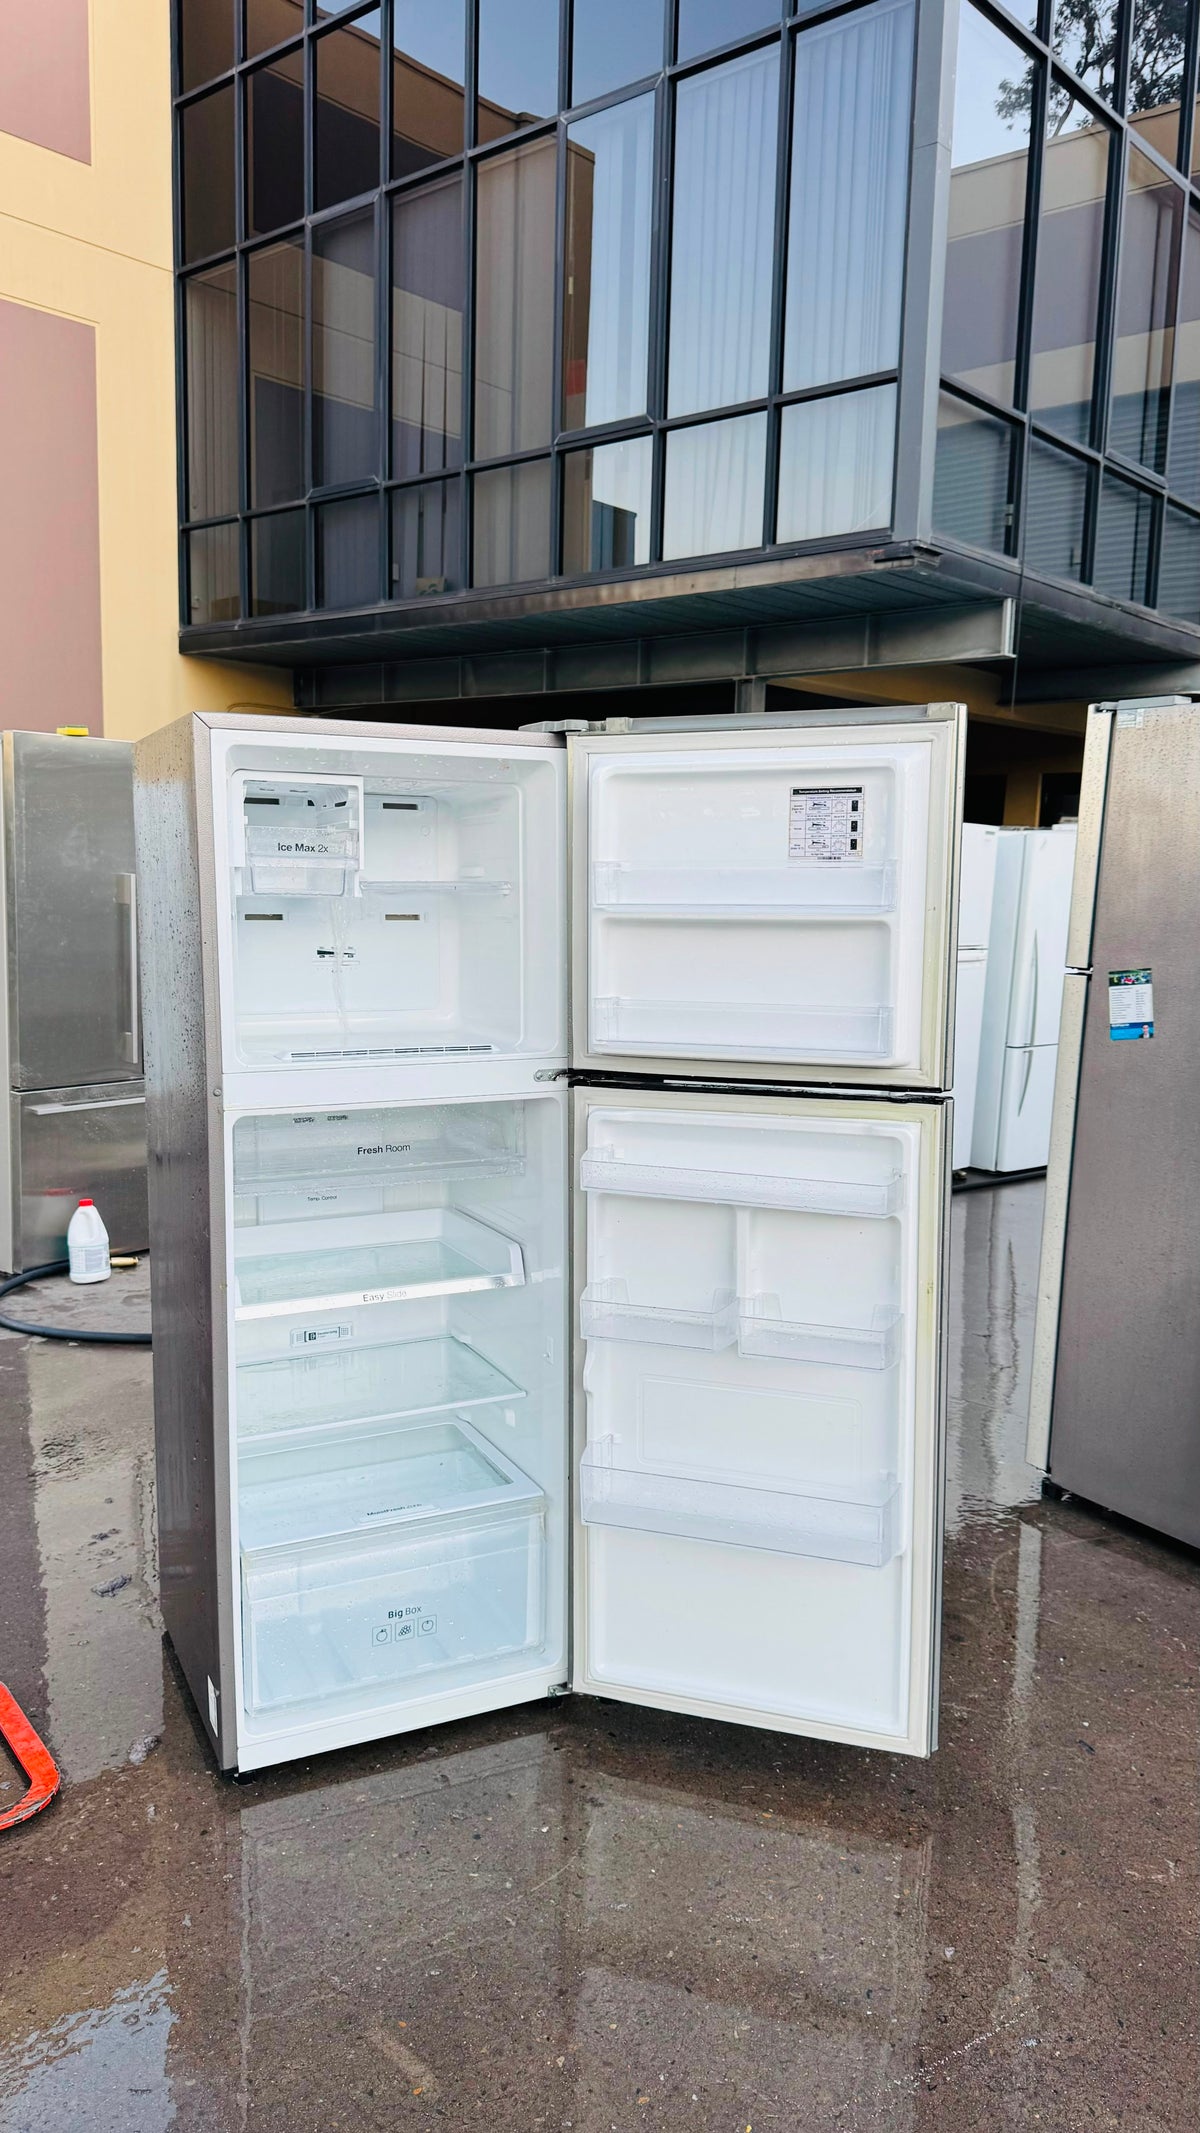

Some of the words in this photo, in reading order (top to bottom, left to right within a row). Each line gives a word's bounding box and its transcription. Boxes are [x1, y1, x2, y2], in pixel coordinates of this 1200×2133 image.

[278, 843, 292, 852] Ice
[295, 843, 315, 852] Max
[318, 844, 329, 853] 2x
[357, 1145, 383, 1155] Fresh
[385, 1144, 411, 1153] Room
[362, 1293, 385, 1303] Easy
[387, 1289, 407, 1299] Slide
[388, 1609, 403, 1620] Big
[405, 1606, 422, 1616] Box
